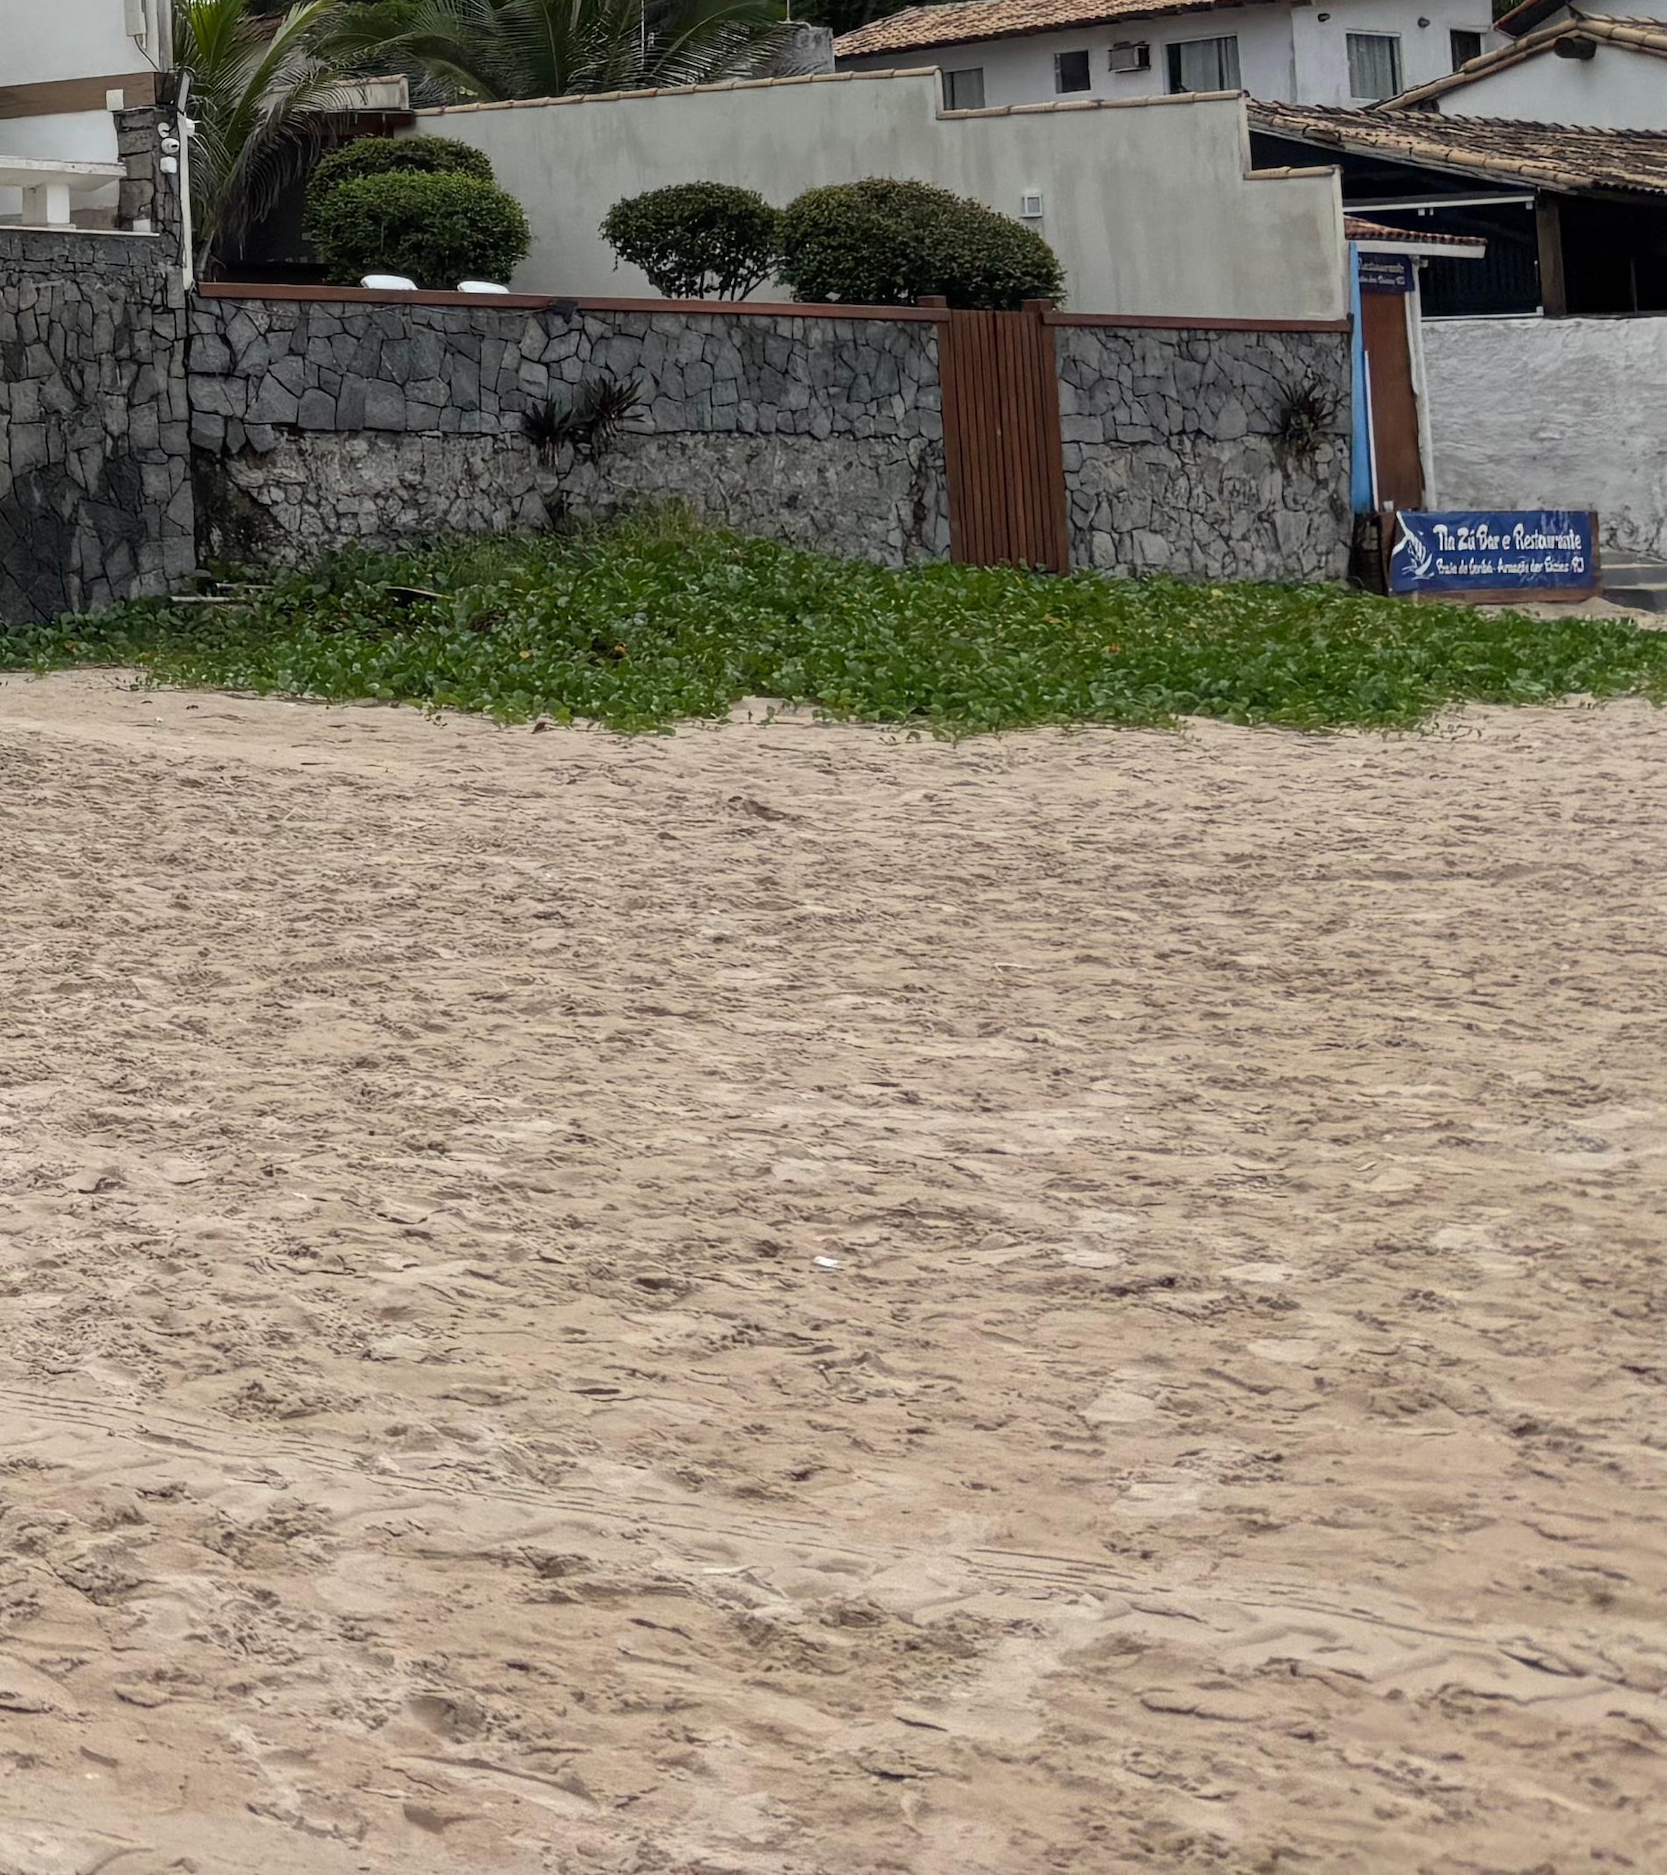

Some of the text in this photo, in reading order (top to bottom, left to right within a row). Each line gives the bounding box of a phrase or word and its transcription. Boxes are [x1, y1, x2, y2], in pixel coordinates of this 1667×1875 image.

[1475, 523, 1501, 551] Bar
[1502, 534, 1511, 550] e
[1513, 522, 1582, 550] Restaurante
